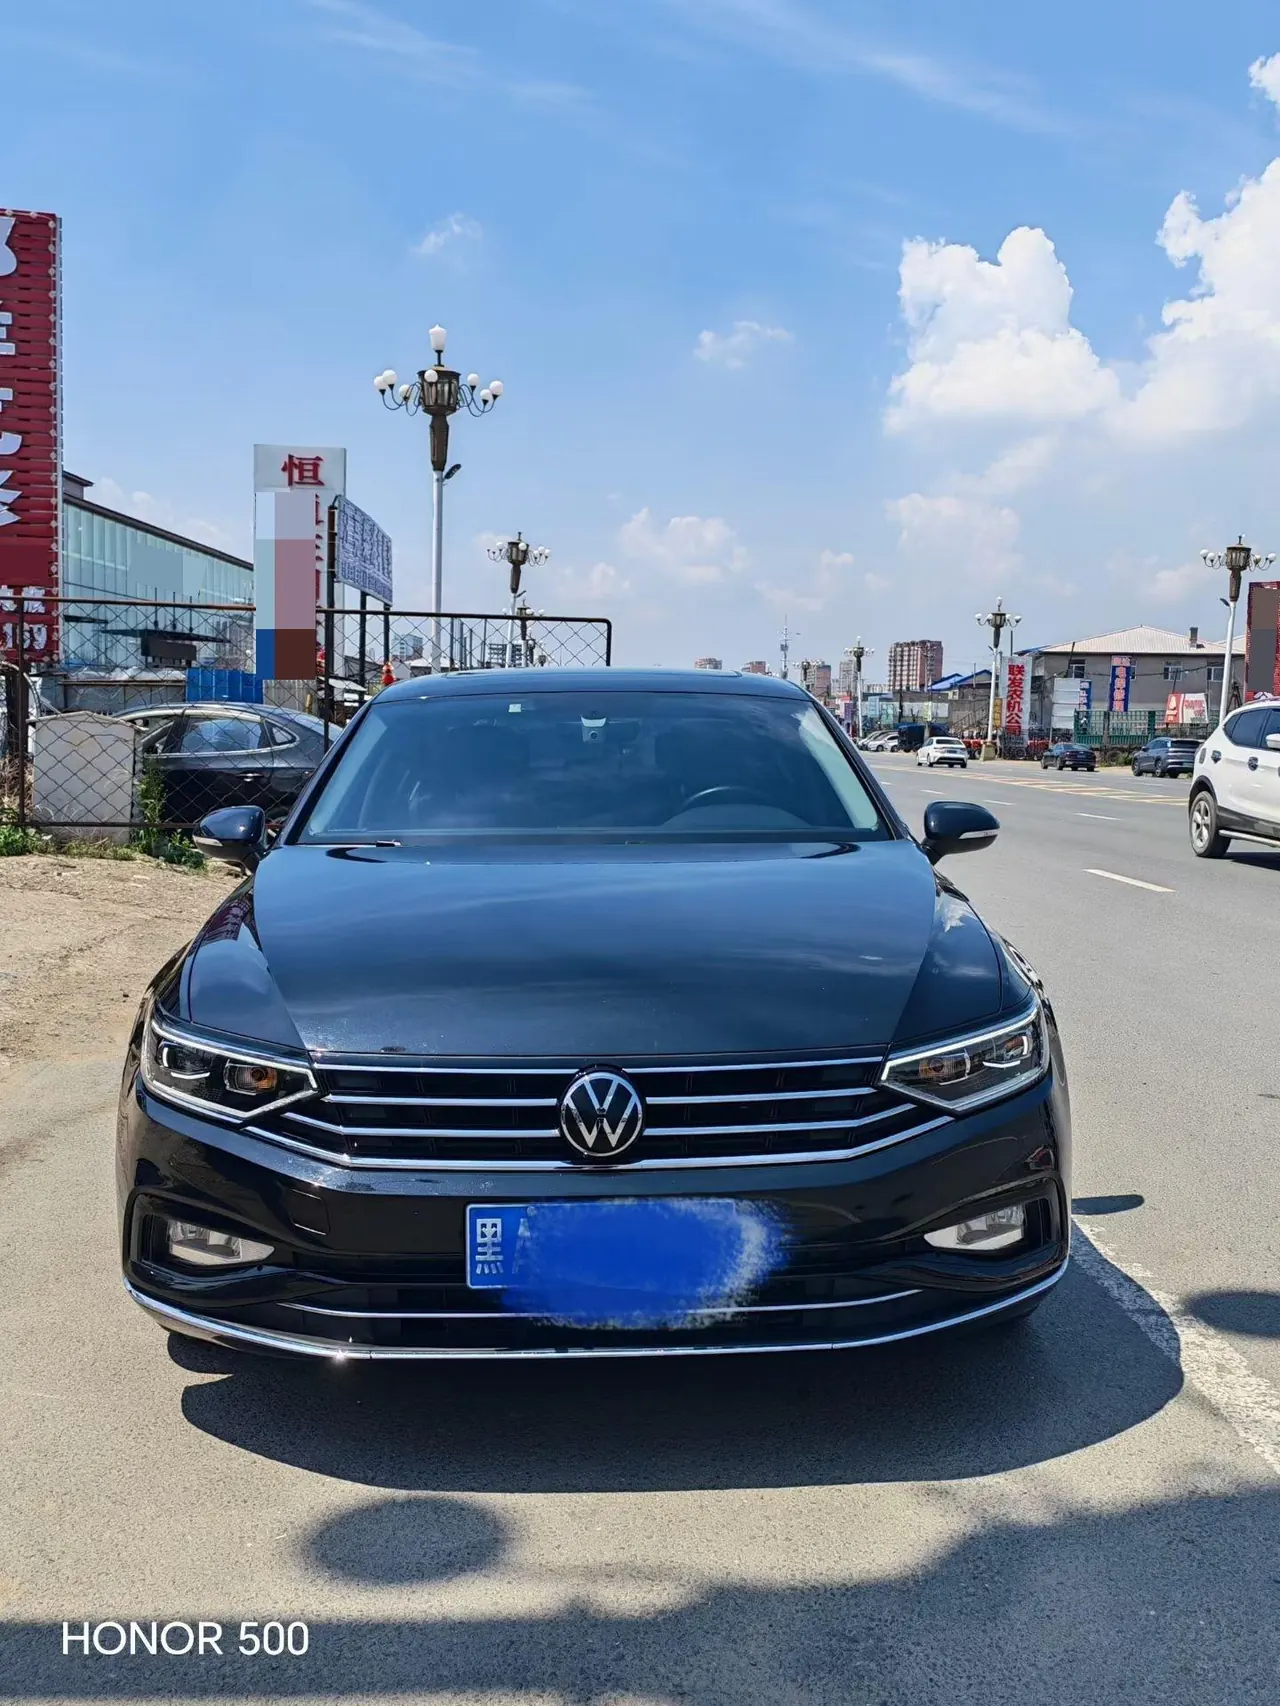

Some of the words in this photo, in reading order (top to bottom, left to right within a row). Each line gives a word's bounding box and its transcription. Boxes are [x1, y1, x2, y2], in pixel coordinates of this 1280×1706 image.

[1006, 664, 1025, 737] 联发农机公司
